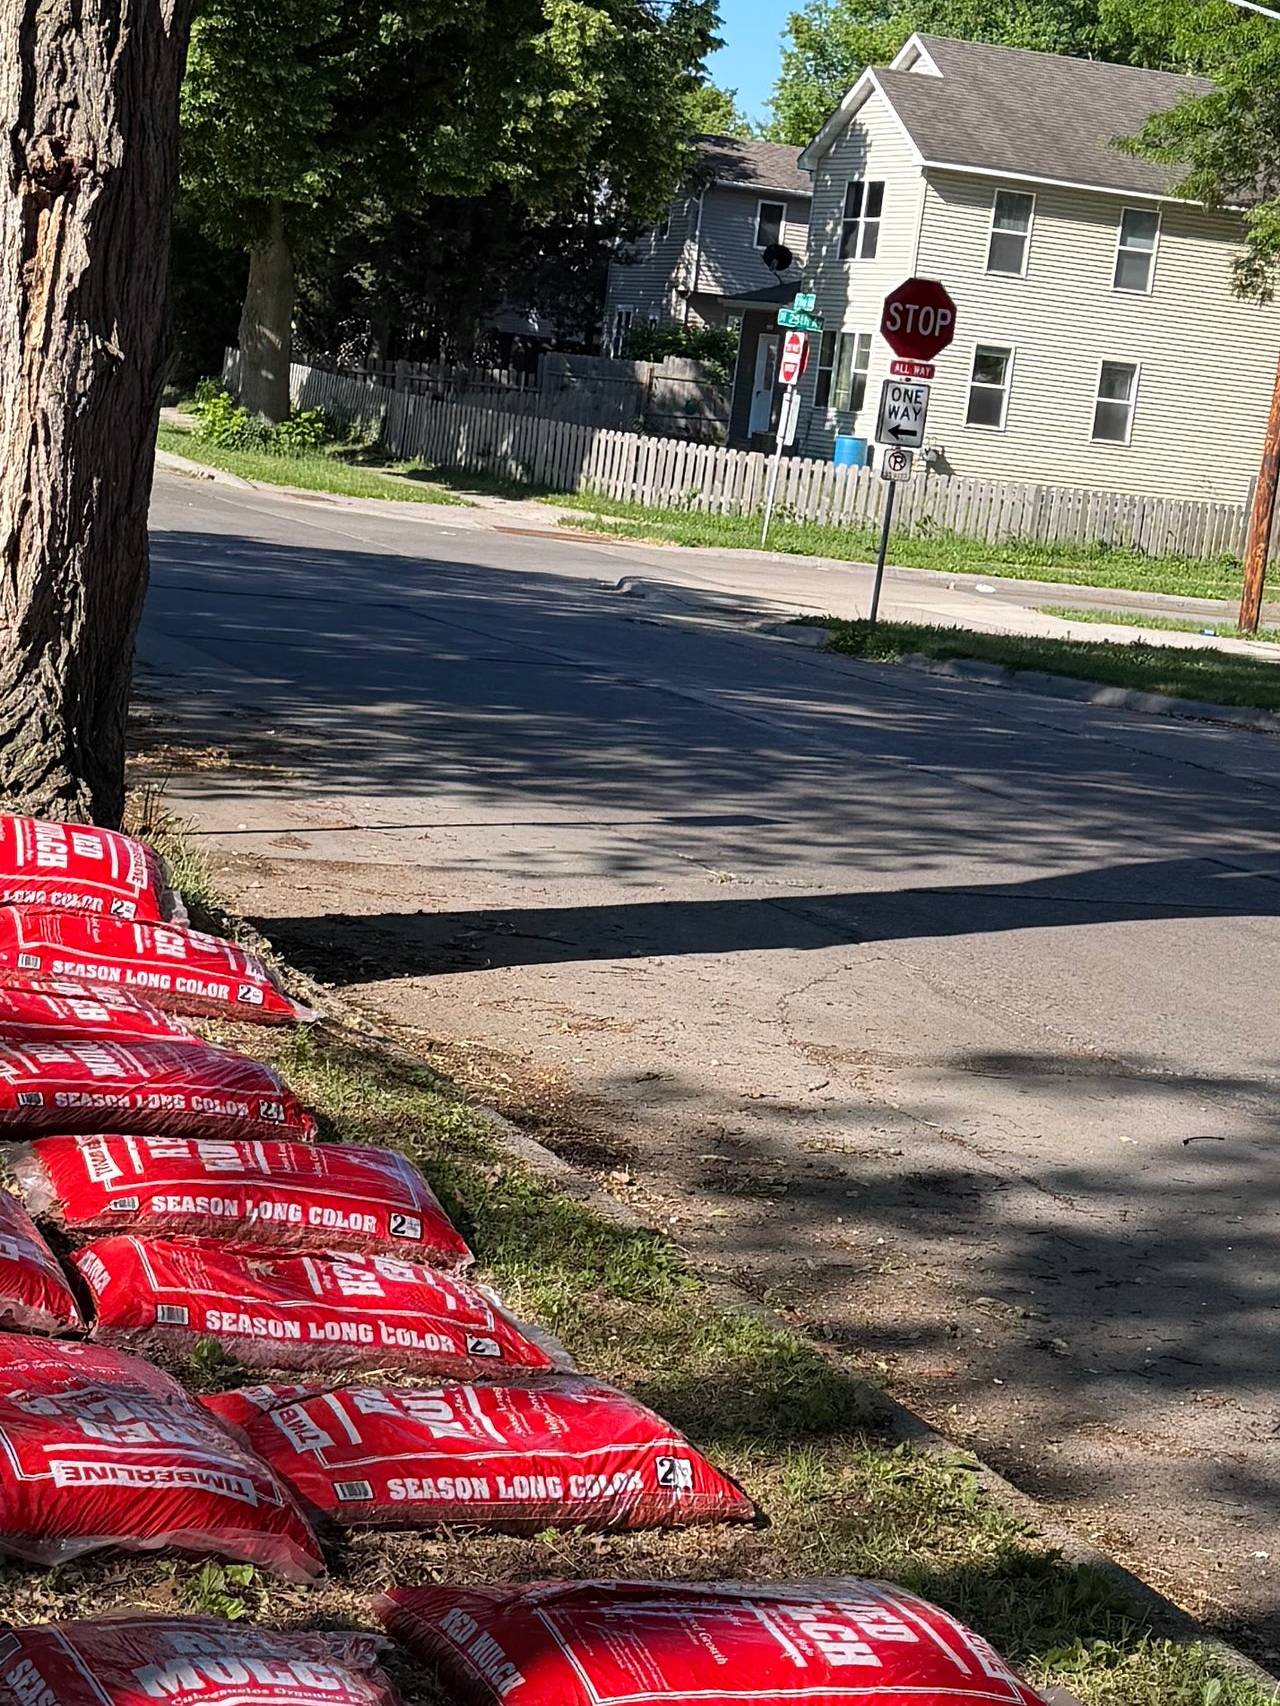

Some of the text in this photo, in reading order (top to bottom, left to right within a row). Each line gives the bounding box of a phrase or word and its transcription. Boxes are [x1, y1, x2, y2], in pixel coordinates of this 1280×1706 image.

[885, 302, 952, 337] STOP
[893, 363, 932, 376] ALL WAY
[891, 387, 923, 405] ONE
[888, 406, 922, 422] WAY
[51, 959, 231, 1000] SEASON LONG COLOR
[54, 1091, 131, 1110] SEASON
[191, 1094, 250, 1117] COLOR
[151, 1195, 378, 1234] SEASON LONG COLOR
[391, 1215, 407, 1235] 2
[205, 1309, 457, 1355] SEASON LONG COLOR
[64, 1463, 256, 1504] TIMBERLINE
[387, 1469, 645, 1502] SEASON LONG COLOR
[658, 1459, 675, 1484] 2
[438, 1607, 527, 1696] RED MULCH
